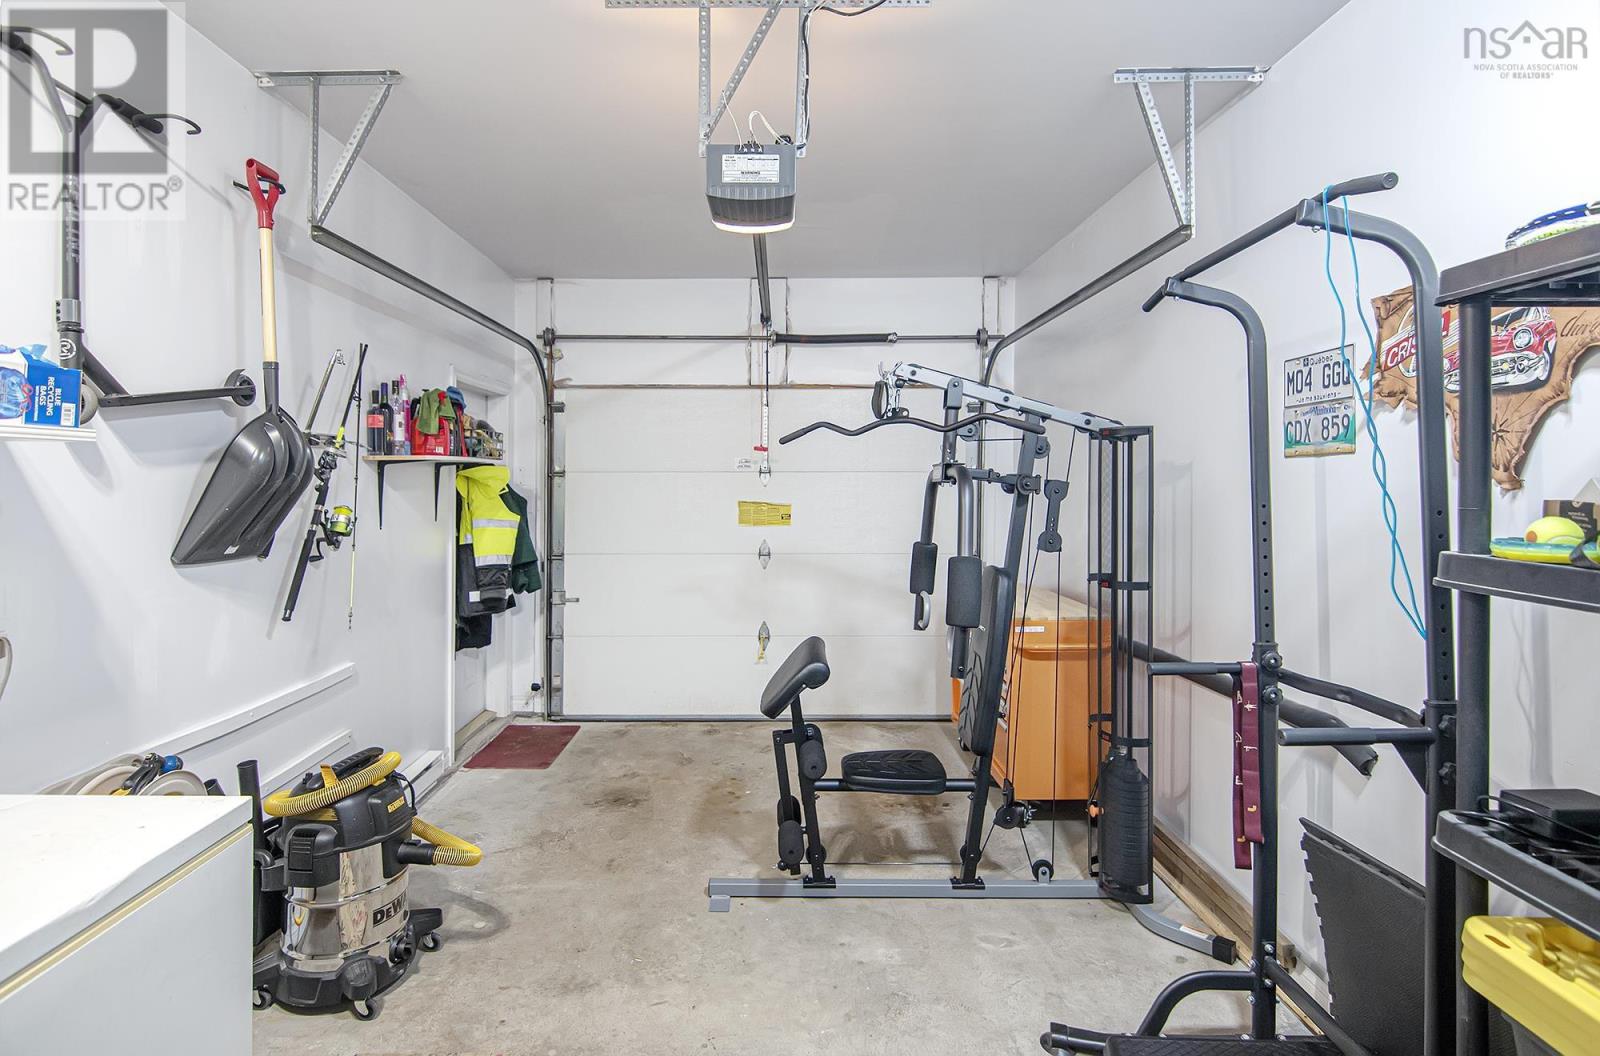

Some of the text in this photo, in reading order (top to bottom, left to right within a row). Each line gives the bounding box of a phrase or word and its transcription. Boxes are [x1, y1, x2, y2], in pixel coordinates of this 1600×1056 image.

[39, 385, 47, 406] BAGS
[46, 377, 55, 416] RECYCLING
[54, 387, 62, 406] BLUE
[1286, 414, 1351, 444] CDX 859
